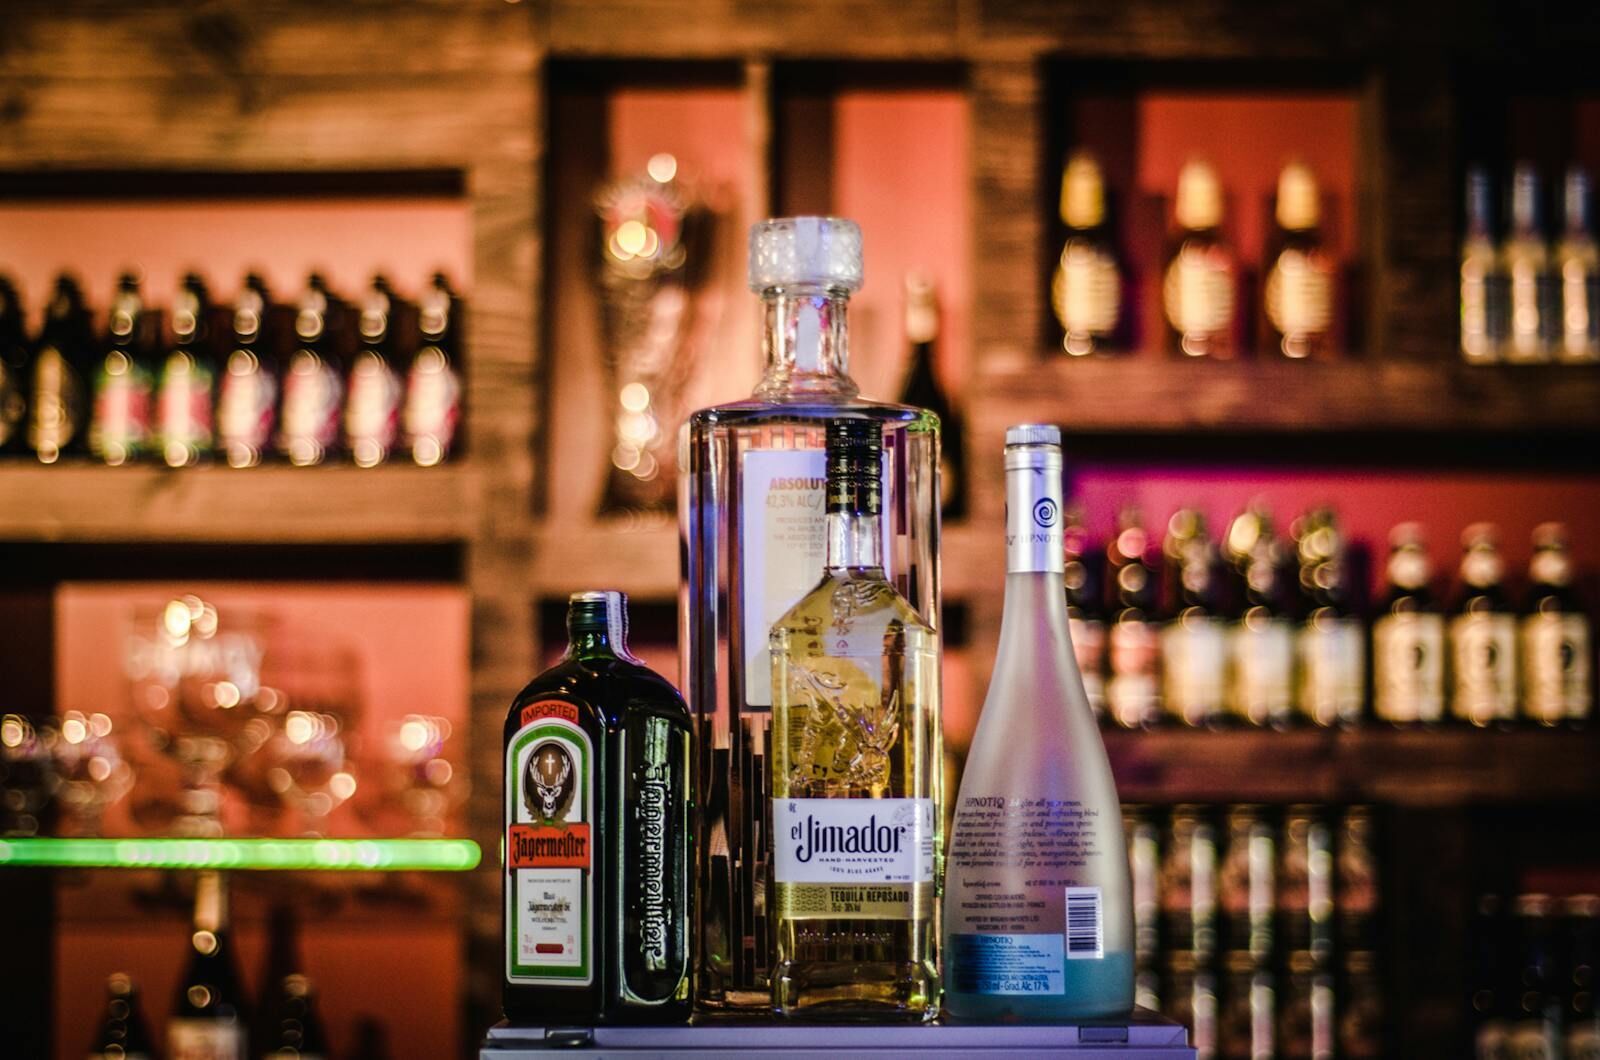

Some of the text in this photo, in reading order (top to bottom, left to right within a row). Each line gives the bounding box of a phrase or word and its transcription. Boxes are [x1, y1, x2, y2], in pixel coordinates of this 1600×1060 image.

[521, 704, 577, 723] IMPORTED
[791, 821, 802, 841] el
[796, 814, 906, 863] Jimador
[831, 890, 909, 902] TEQUILA REPOSADO
[1004, 981, 1019, 991] Grad.
[1034, 981, 1042, 990] 17
